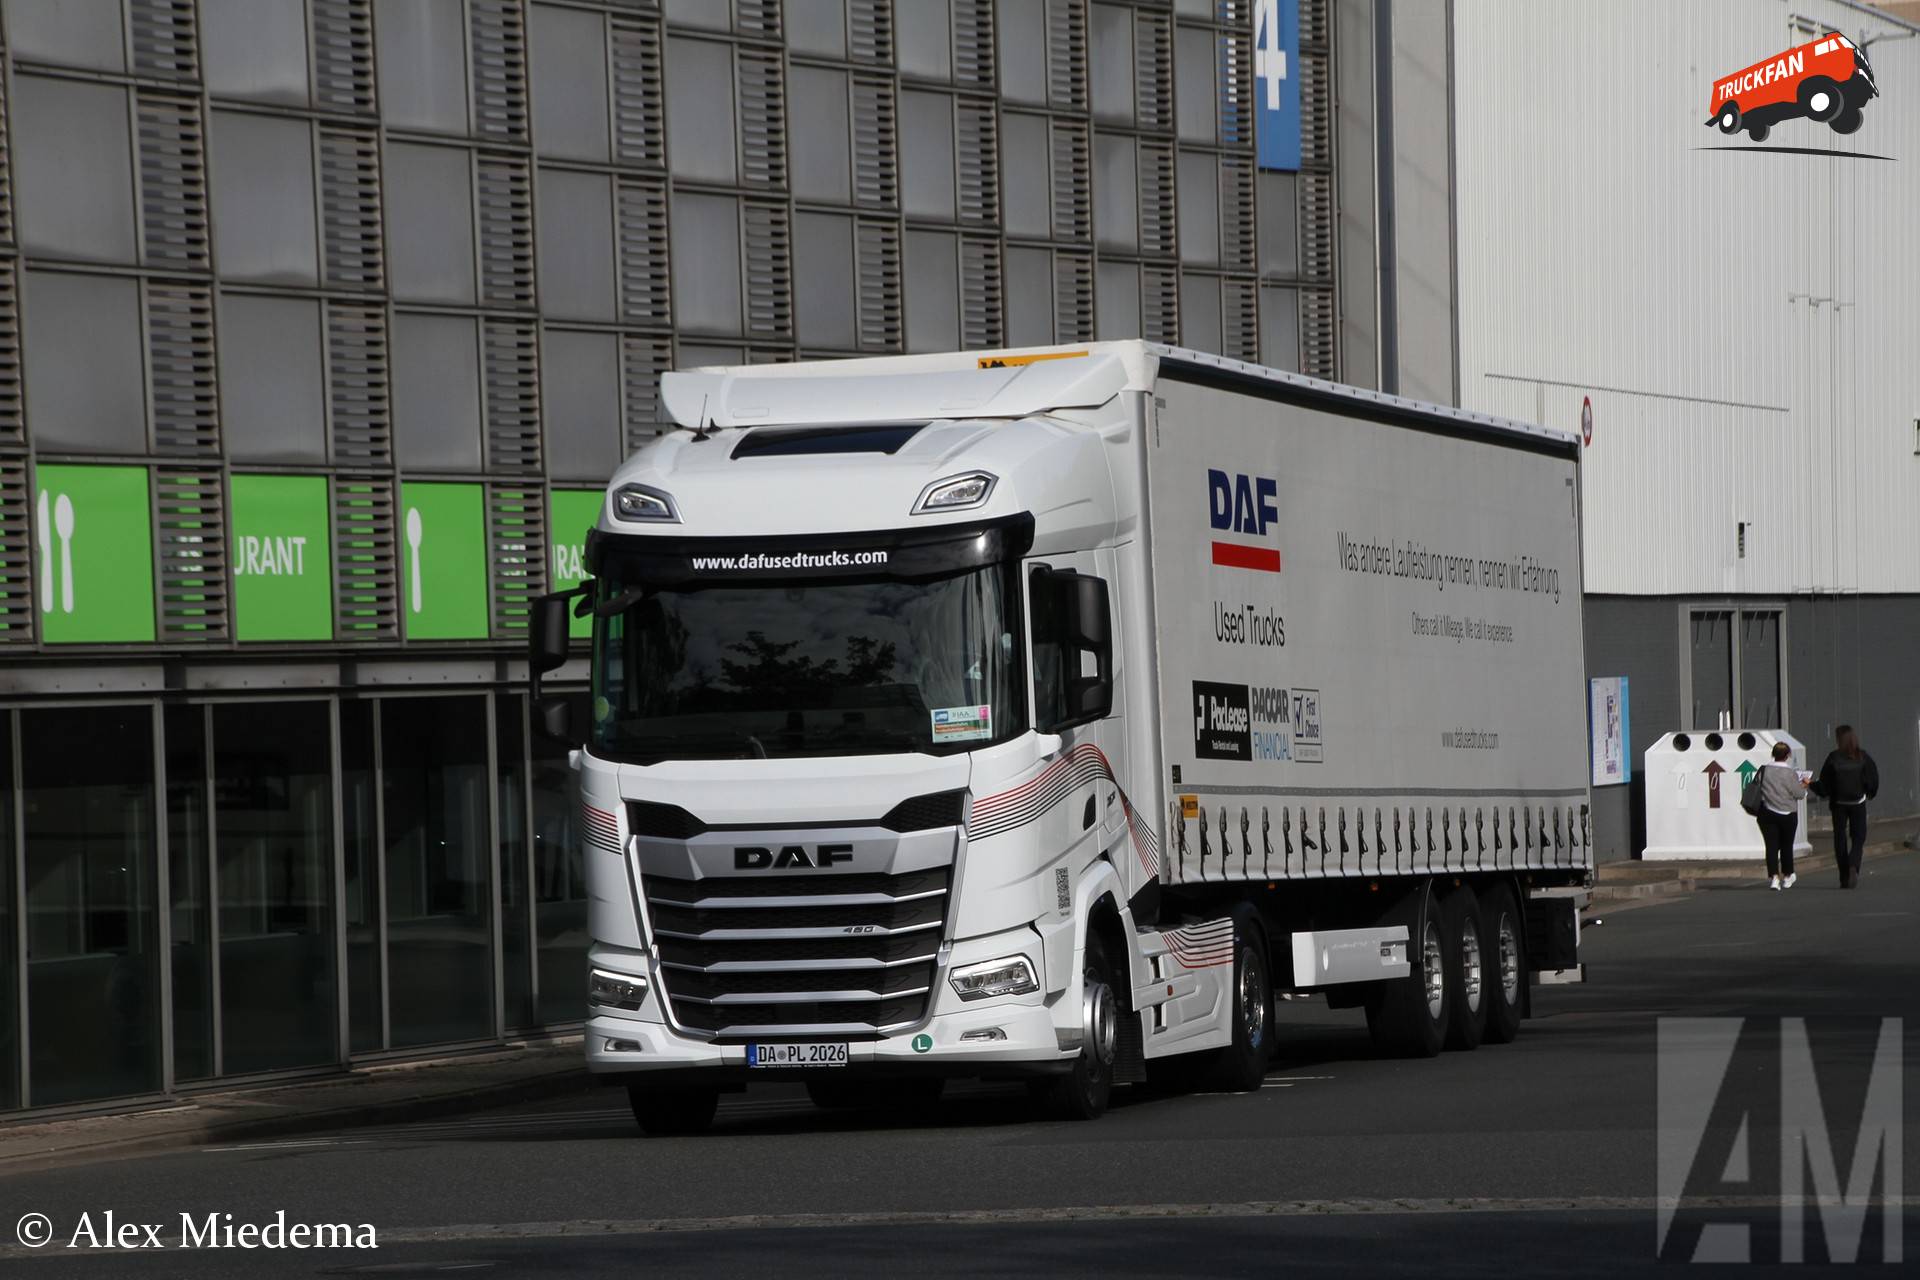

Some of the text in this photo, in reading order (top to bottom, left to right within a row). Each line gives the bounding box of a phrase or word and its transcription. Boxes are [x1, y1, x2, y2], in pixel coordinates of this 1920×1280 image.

[1208, 469, 1278, 536] DAF
[692, 551, 888, 569] www.dafusedtrucks.com
[1337, 531, 1358, 572] Was
[1361, 536, 1390, 575] andere
[1392, 538, 1443, 591] Laufleistung
[1479, 560, 1508, 591] nennen
[1214, 601, 1285, 647] Used Trucks
[1211, 696, 1248, 733] PacLease
[1252, 687, 1290, 723] PACCAR
[1254, 732, 1292, 760] FINANCIAL
[734, 844, 853, 869] DAF
[758, 1043, 846, 1062] DA PL 2026
